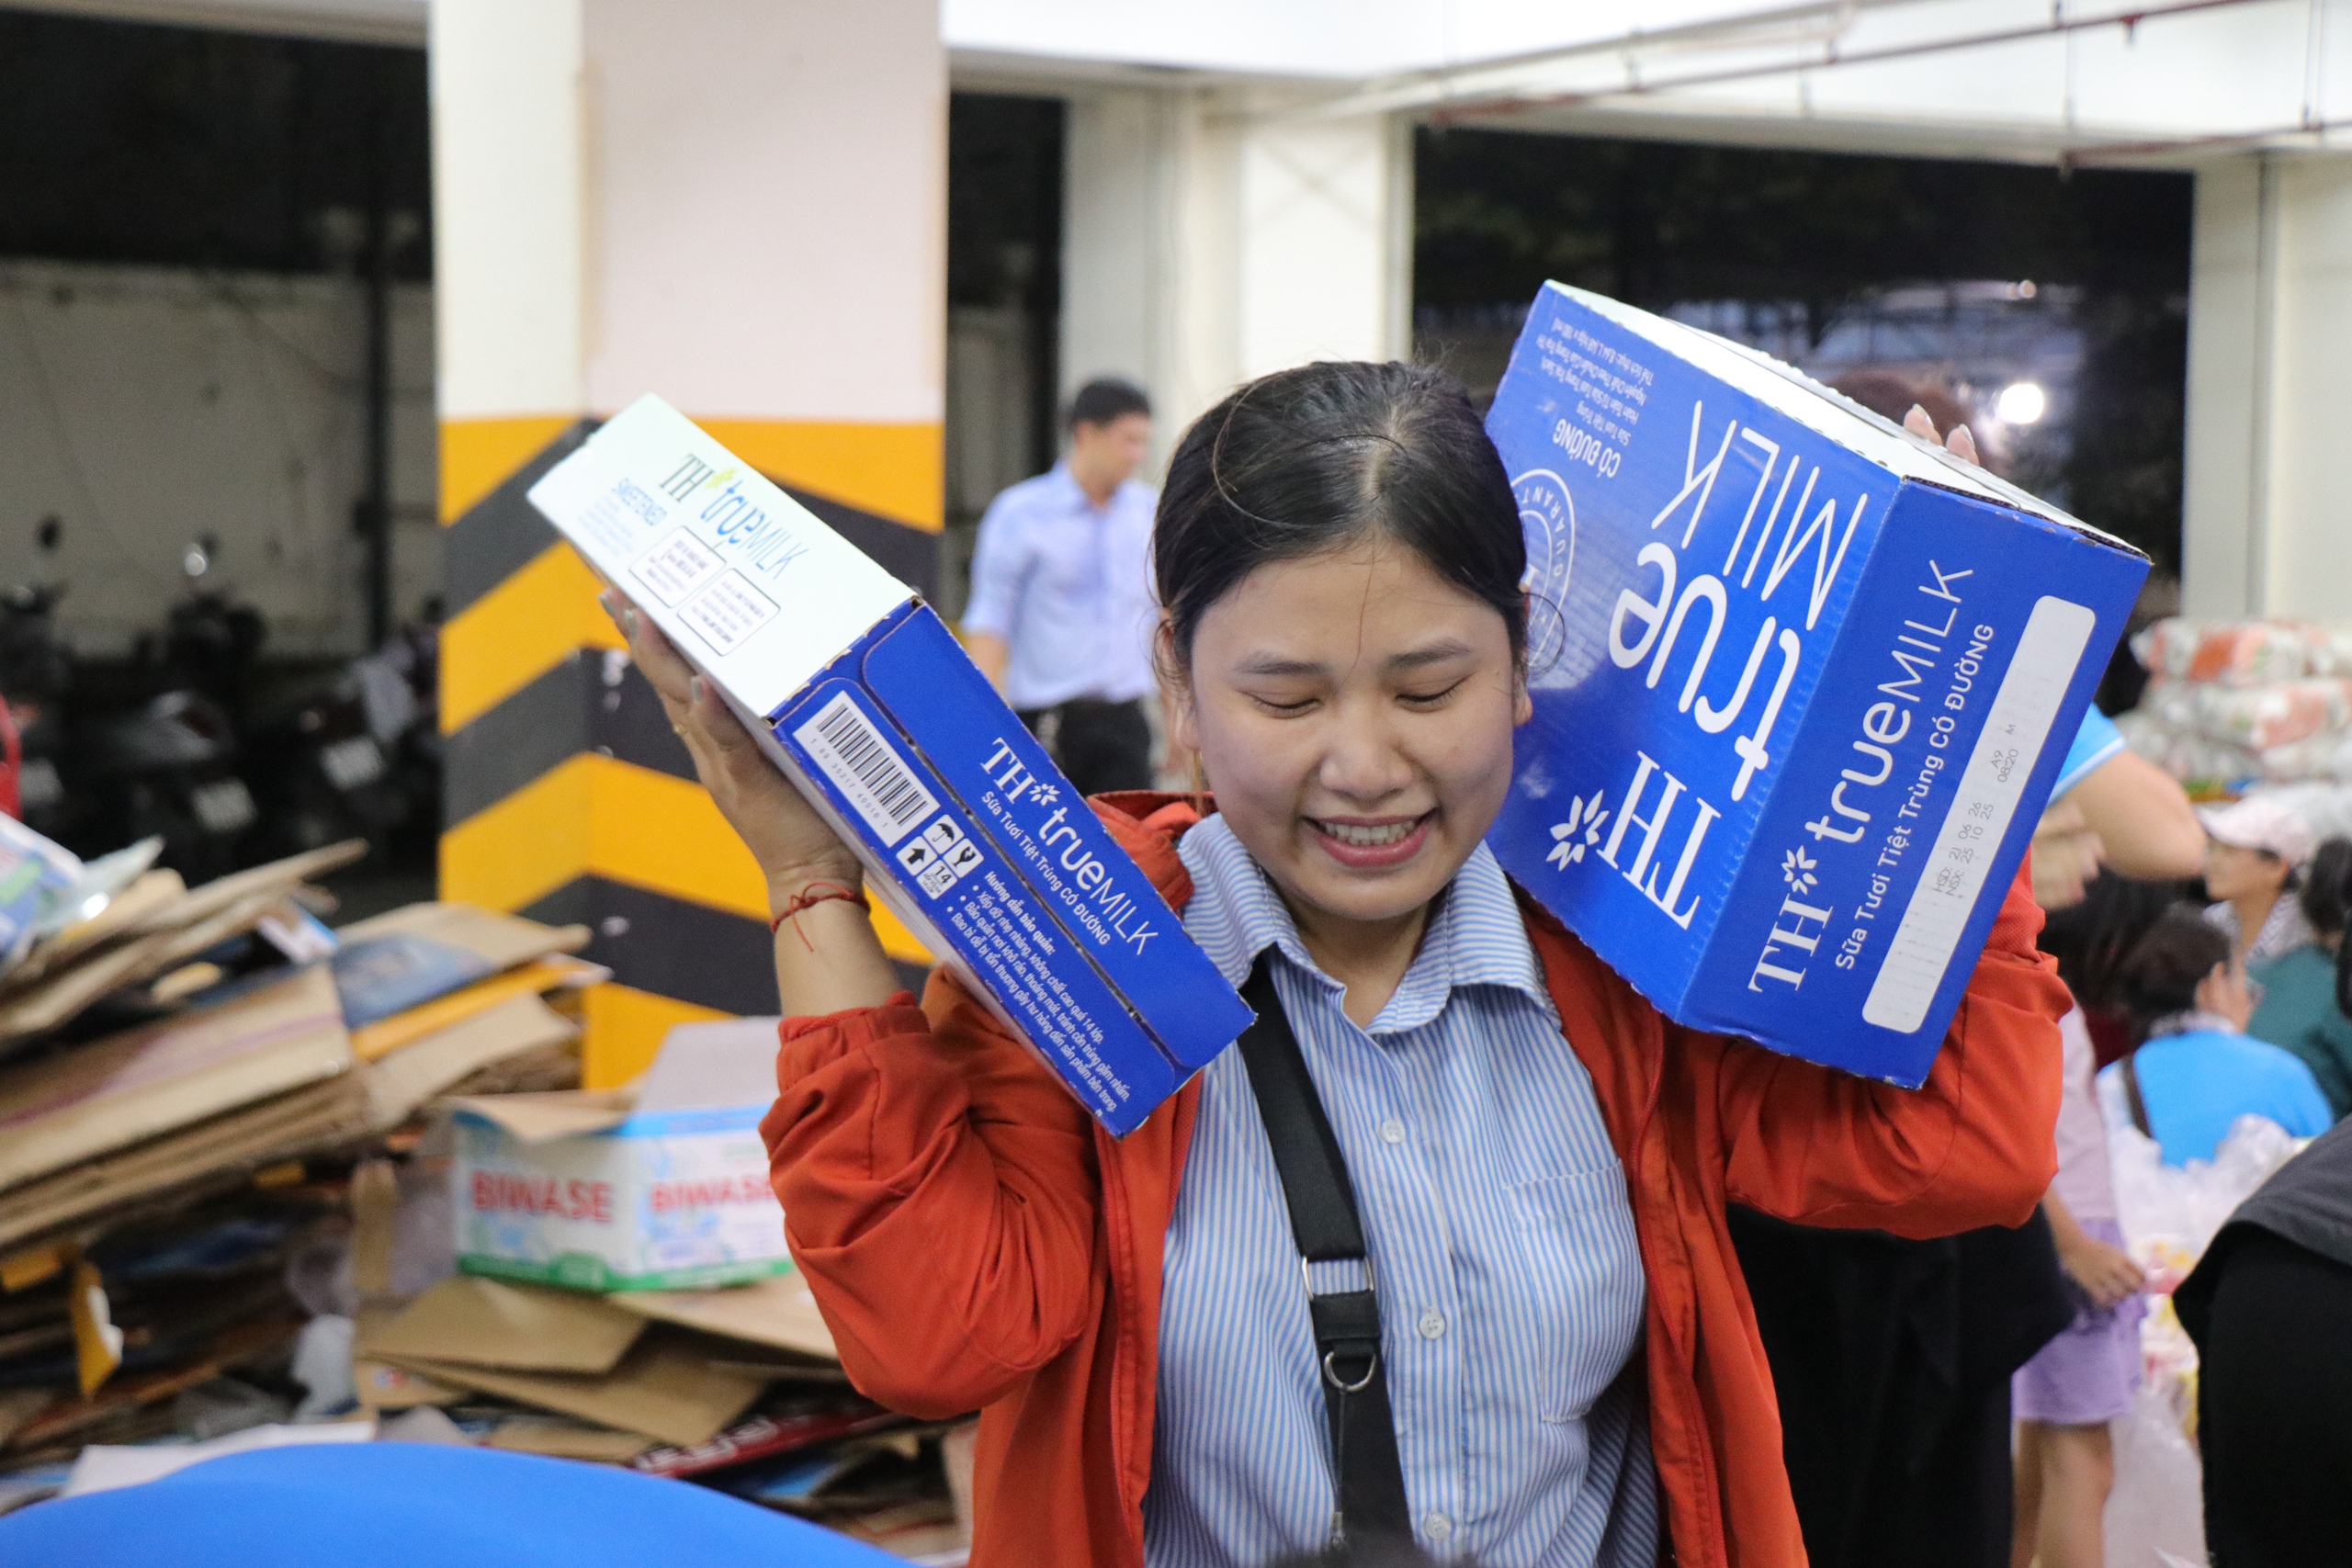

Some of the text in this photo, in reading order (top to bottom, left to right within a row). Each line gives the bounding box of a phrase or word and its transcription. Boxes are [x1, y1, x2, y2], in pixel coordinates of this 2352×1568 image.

[658, 453, 716, 503] TH
[1595, 446, 1622, 481] CÓ
[1651, 400, 1869, 631] MILK
[1609, 542, 1801, 801] true
[978, 736, 1038, 805] TH
[1833, 622, 1996, 970] Sữa Tươi Tiệt Trùng CÓ ĐƯỜNG
[1596, 750, 1721, 930] TH
[1931, 865, 1953, 893] HSD:
[1948, 846, 1962, 861] 21
[1956, 822, 1973, 840] 06
[1966, 800, 1983, 818] 26
[1989, 749, 2005, 770] A9
[1945, 748, 2019, 895] NSX: 25 10 25 08:20
[934, 865, 953, 885] 14
[980, 790, 1112, 947] Sữa Tươi Tiệt Trùng CÓ ĐƯỜNG
[975, 889, 997, 910] Xếp
[983, 869, 1057, 957] Hướng dẫn bảo quản:
[995, 915, 1014, 935] nhẹ
[1007, 929, 1034, 959] nhàng,
[1027, 952, 1053, 981] không
[1747, 892, 1834, 996] TH
[963, 900, 1133, 1102] Bảo quản nơi khô ráo, thoáng mát, tránh côn trùng gặm nhấm.
[1046, 974, 1068, 996] chất
[1058, 990, 1076, 1009] cao
[950, 911, 1118, 1114] Bao bì dễ bị tổn thương gây hư hỏng đến sản phẩm bên trong.
[1069, 1003, 1089, 1023] quá
[1081, 1017, 1096, 1032] 14
[1088, 1025, 1105, 1046] lớp.
[471, 1170, 613, 1223] BIWASE
